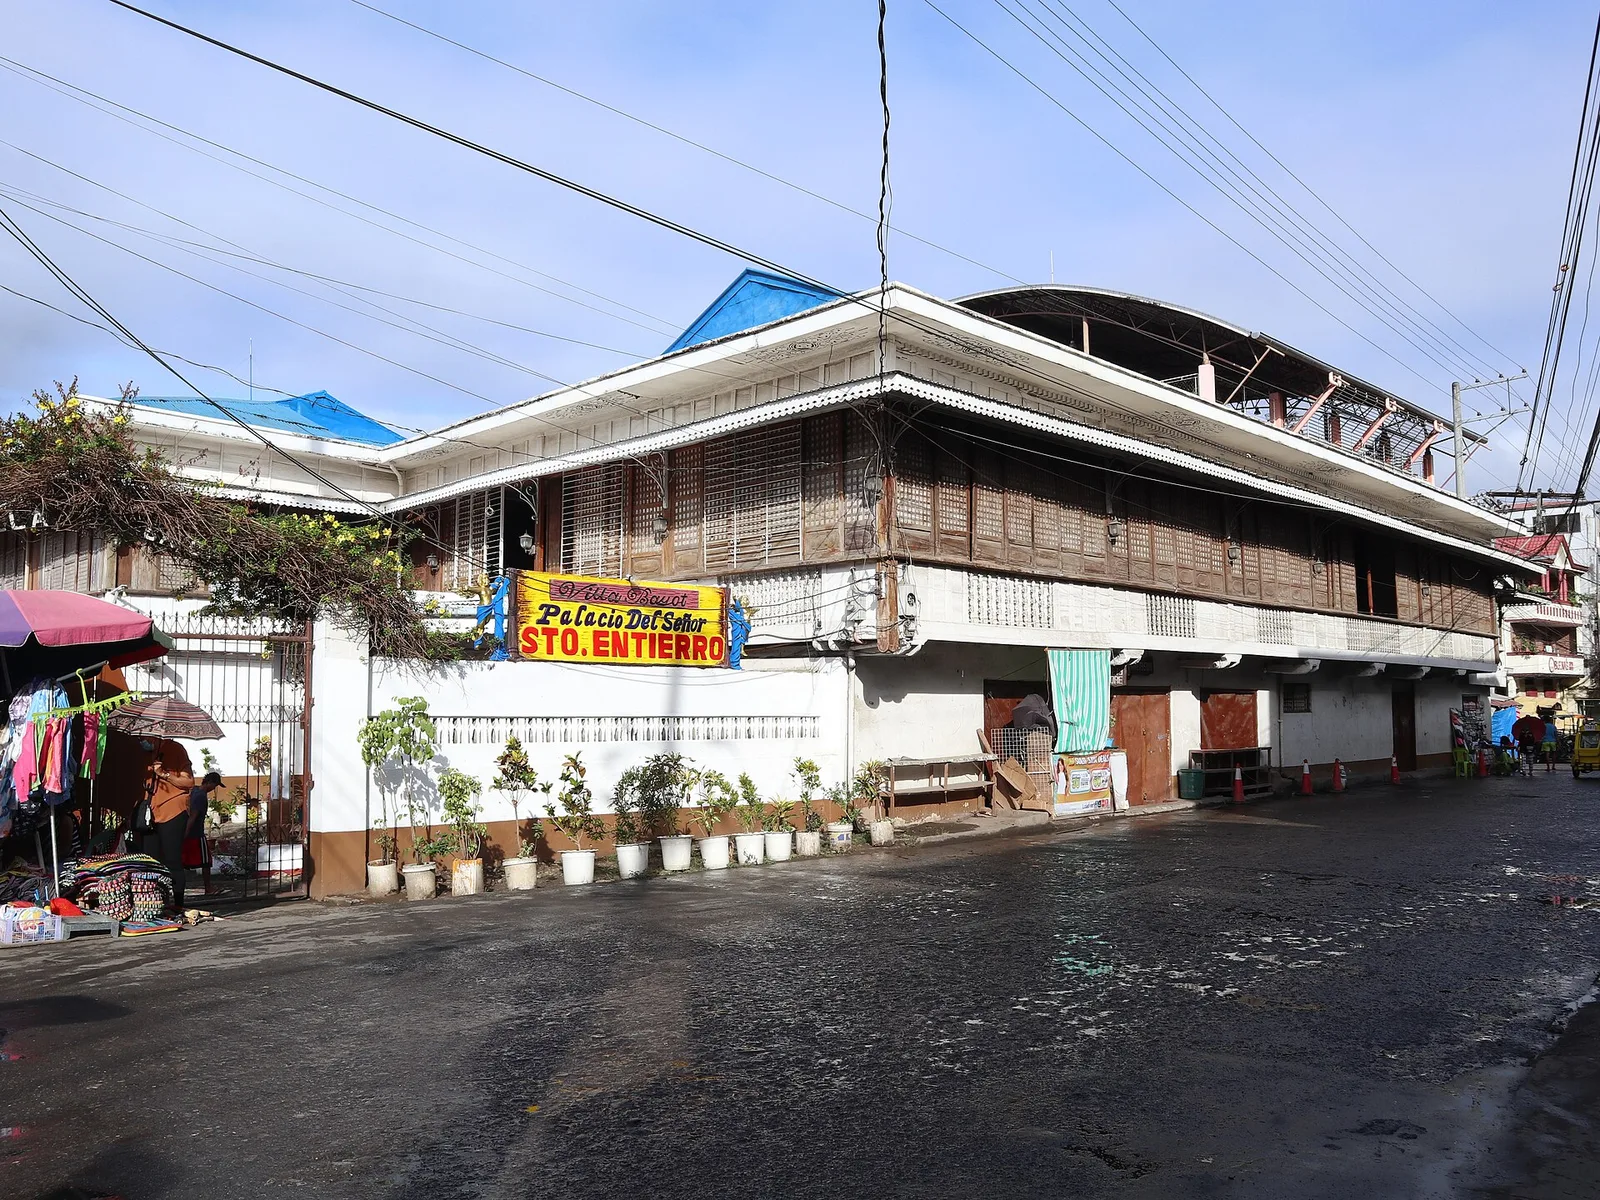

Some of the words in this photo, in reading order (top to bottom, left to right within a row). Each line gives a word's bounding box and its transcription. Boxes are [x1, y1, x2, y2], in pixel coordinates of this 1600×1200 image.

[559, 581, 622, 603] Villa
[536, 603, 623, 629] Palacio
[625, 608, 662, 631] Del
[661, 611, 707, 633] Señor
[521, 627, 587, 657] STO.
[593, 630, 725, 661] ENTIERRO
